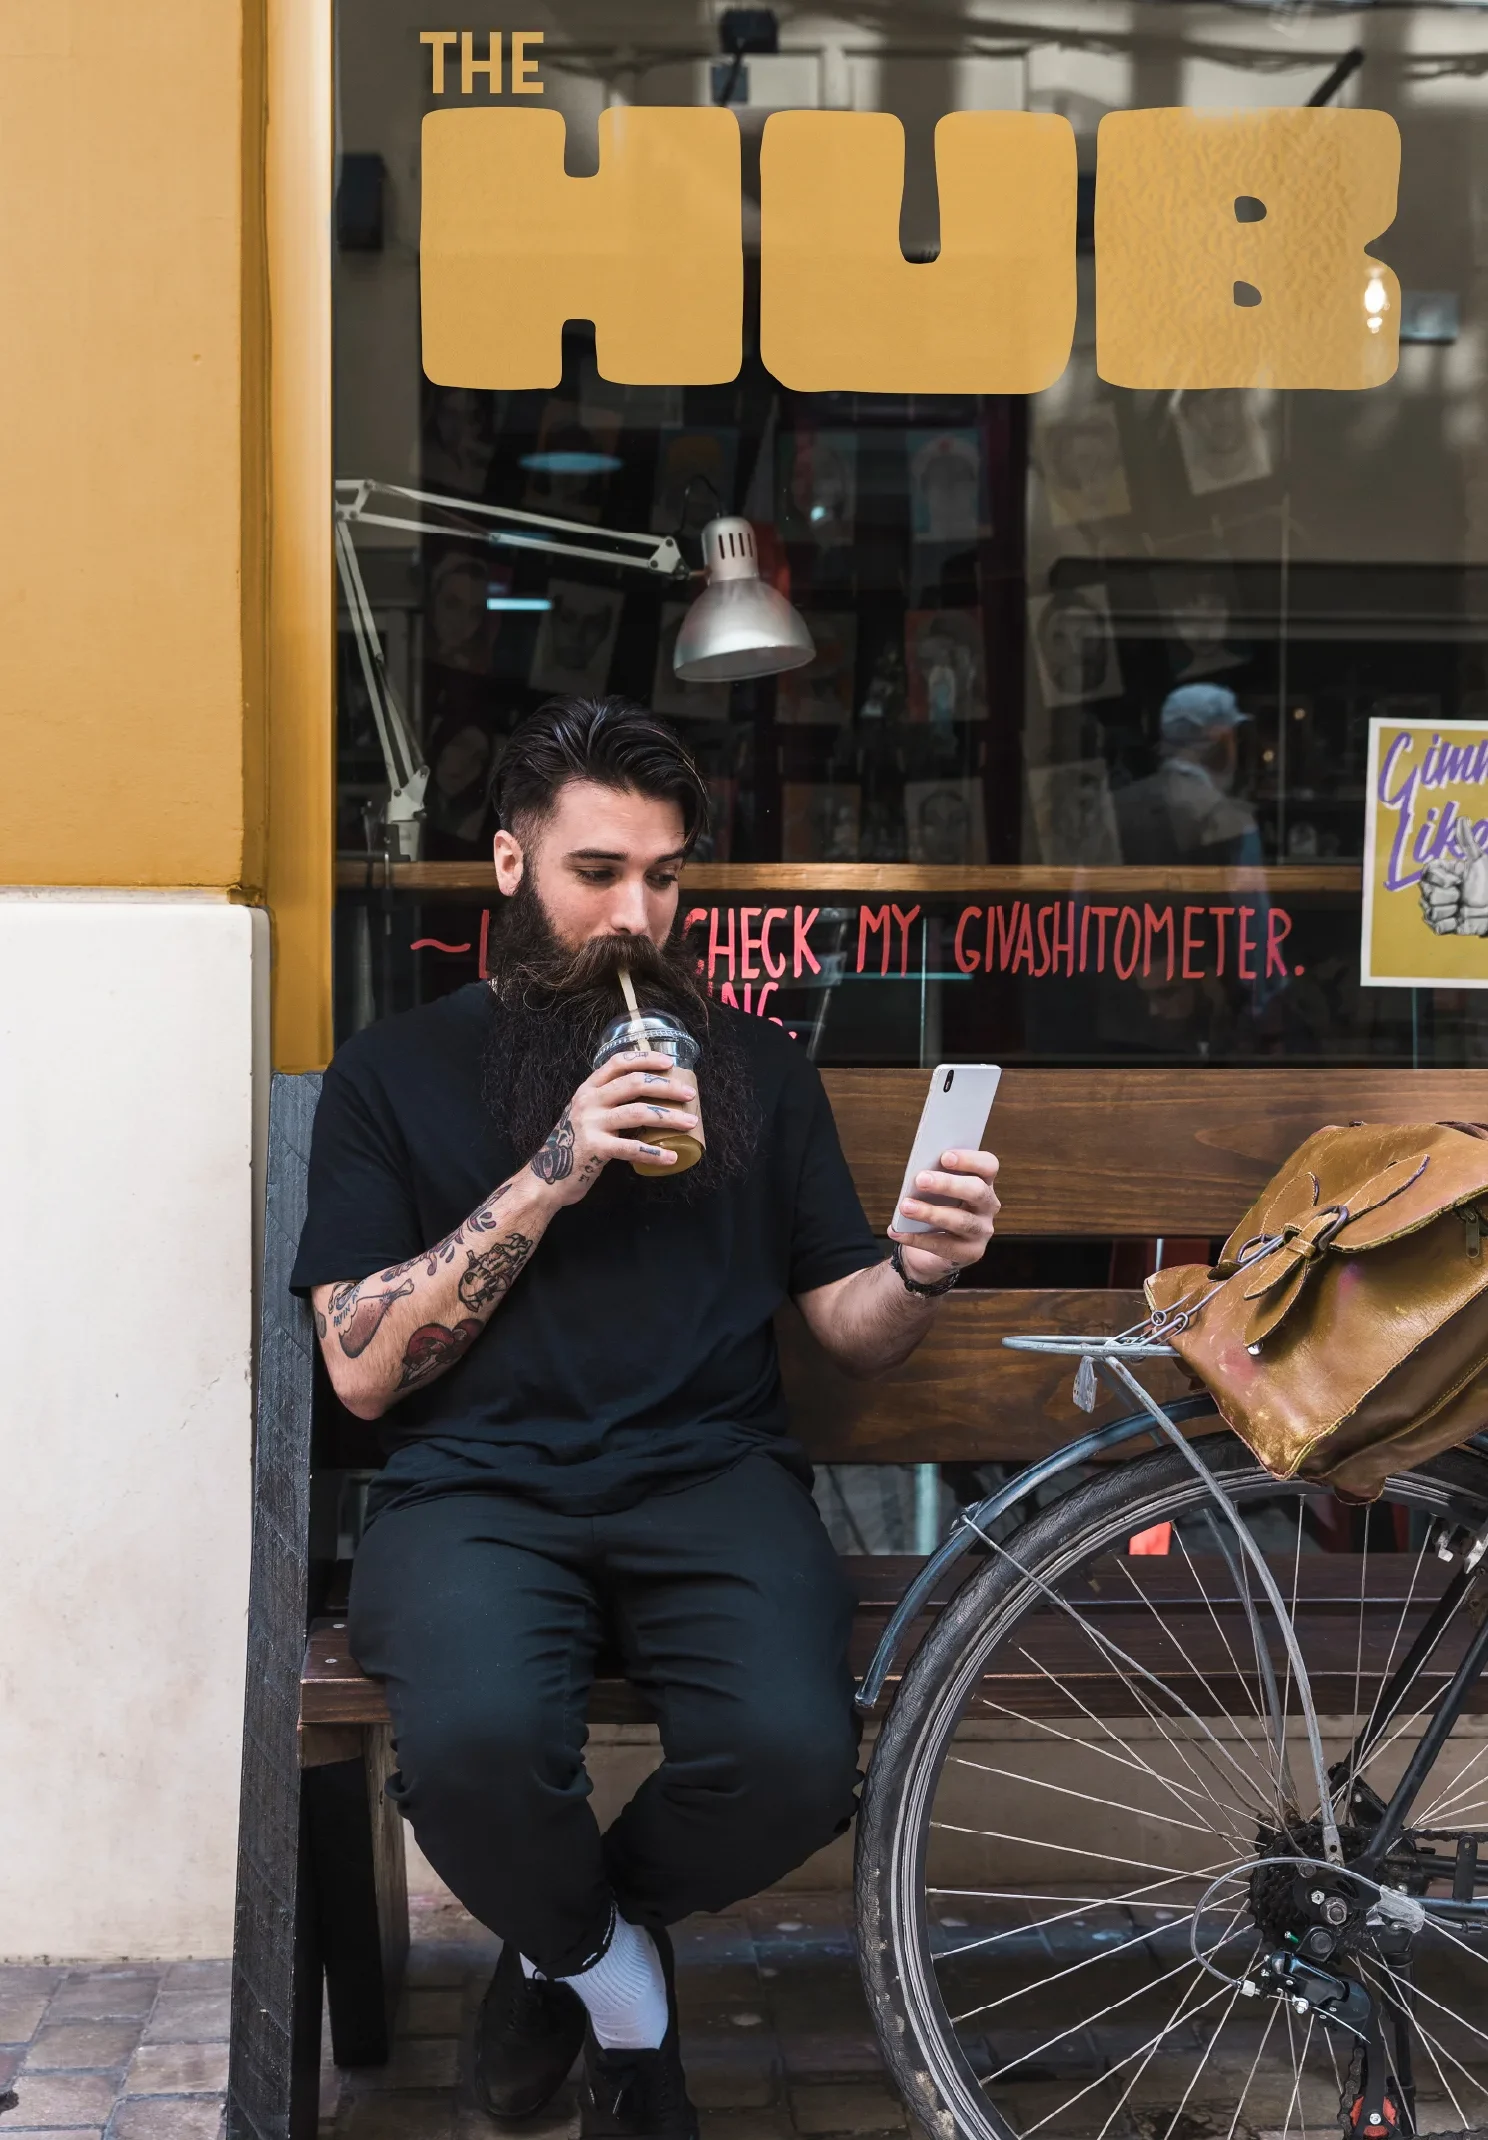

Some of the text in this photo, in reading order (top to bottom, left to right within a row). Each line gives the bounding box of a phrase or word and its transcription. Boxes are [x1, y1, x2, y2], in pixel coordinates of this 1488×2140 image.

[421, 31, 545, 94] THE
[419, 106, 1402, 395] HUB
[1377, 731, 1488, 810] Gim
[857, 904, 921, 977] MY
[955, 901, 1305, 981] GIVASHITOMETER.
